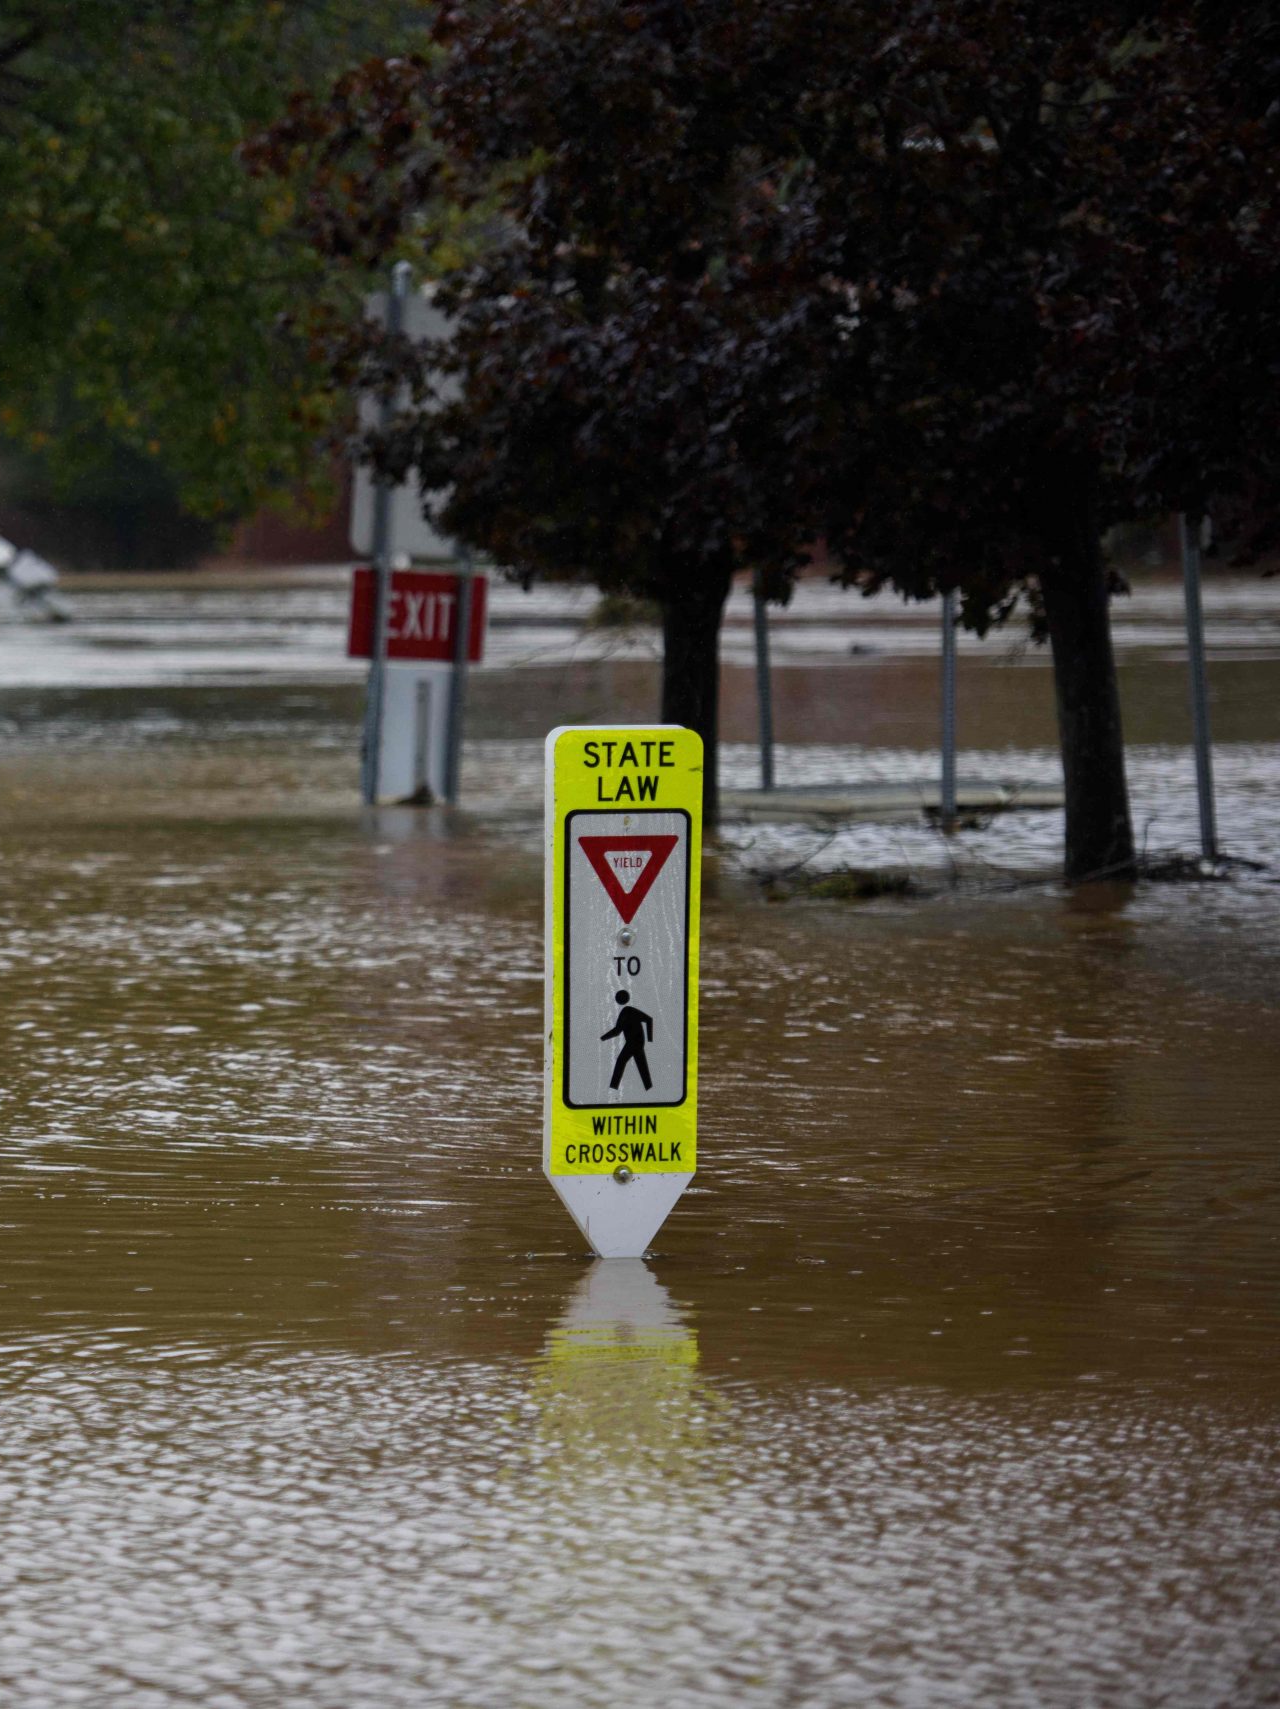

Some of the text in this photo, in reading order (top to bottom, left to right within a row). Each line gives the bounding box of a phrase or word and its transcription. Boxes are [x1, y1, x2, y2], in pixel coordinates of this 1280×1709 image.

[583, 741, 675, 768] STATE
[597, 776, 659, 802] LAW
[613, 857, 643, 868] YIELD
[614, 956, 641, 976] TO
[592, 1115, 657, 1135] WITHIN
[565, 1142, 682, 1163] CROSSWALK
